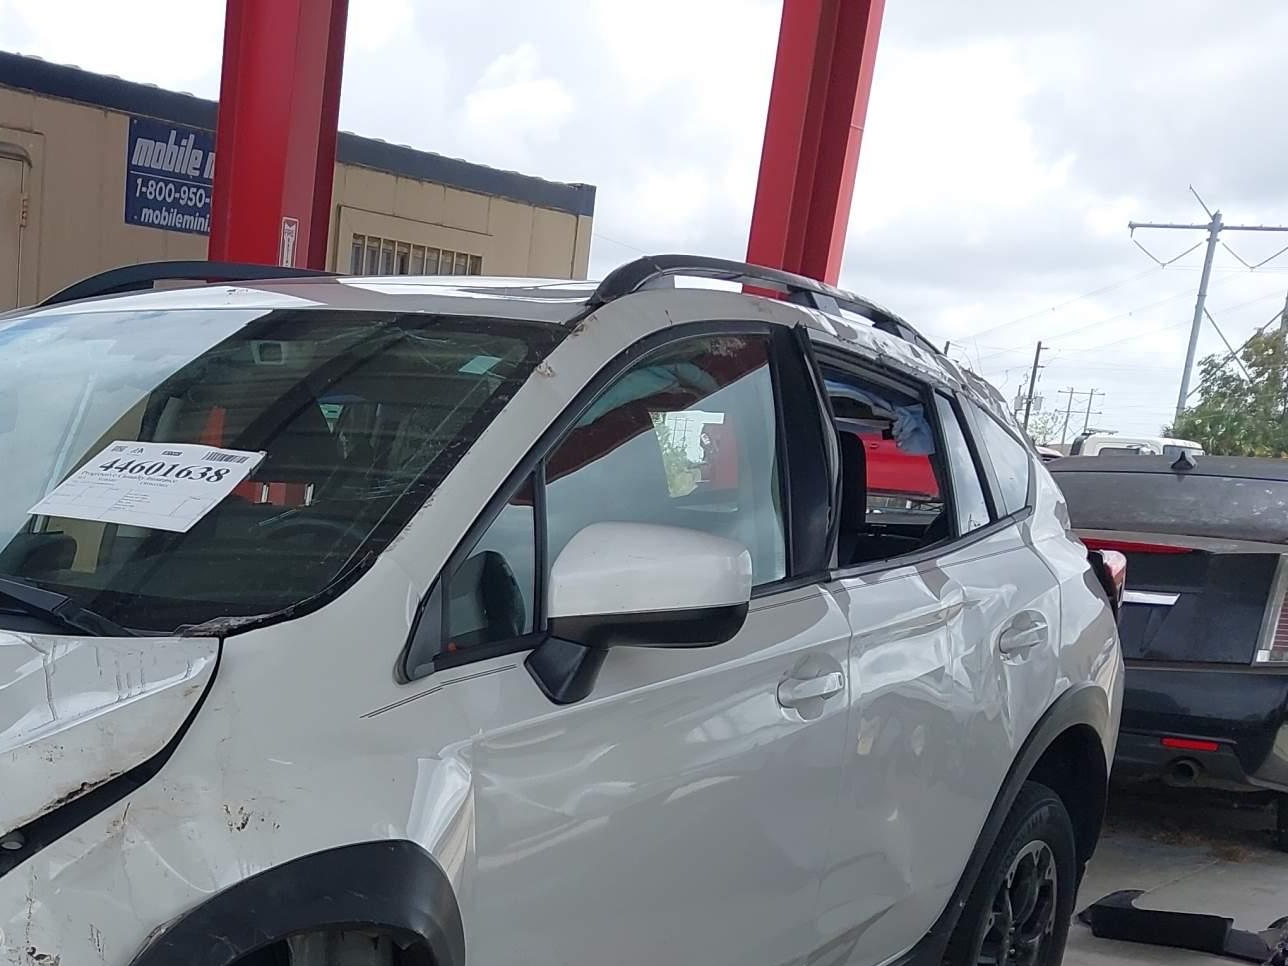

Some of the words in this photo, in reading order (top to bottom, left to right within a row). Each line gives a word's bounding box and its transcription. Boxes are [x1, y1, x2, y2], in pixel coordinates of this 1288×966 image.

[132, 129, 203, 177] mobile
[136, 178, 212, 208] 1-800-950-
[141, 207, 210, 232] mobilemini.
[99, 457, 231, 483] 44601638
